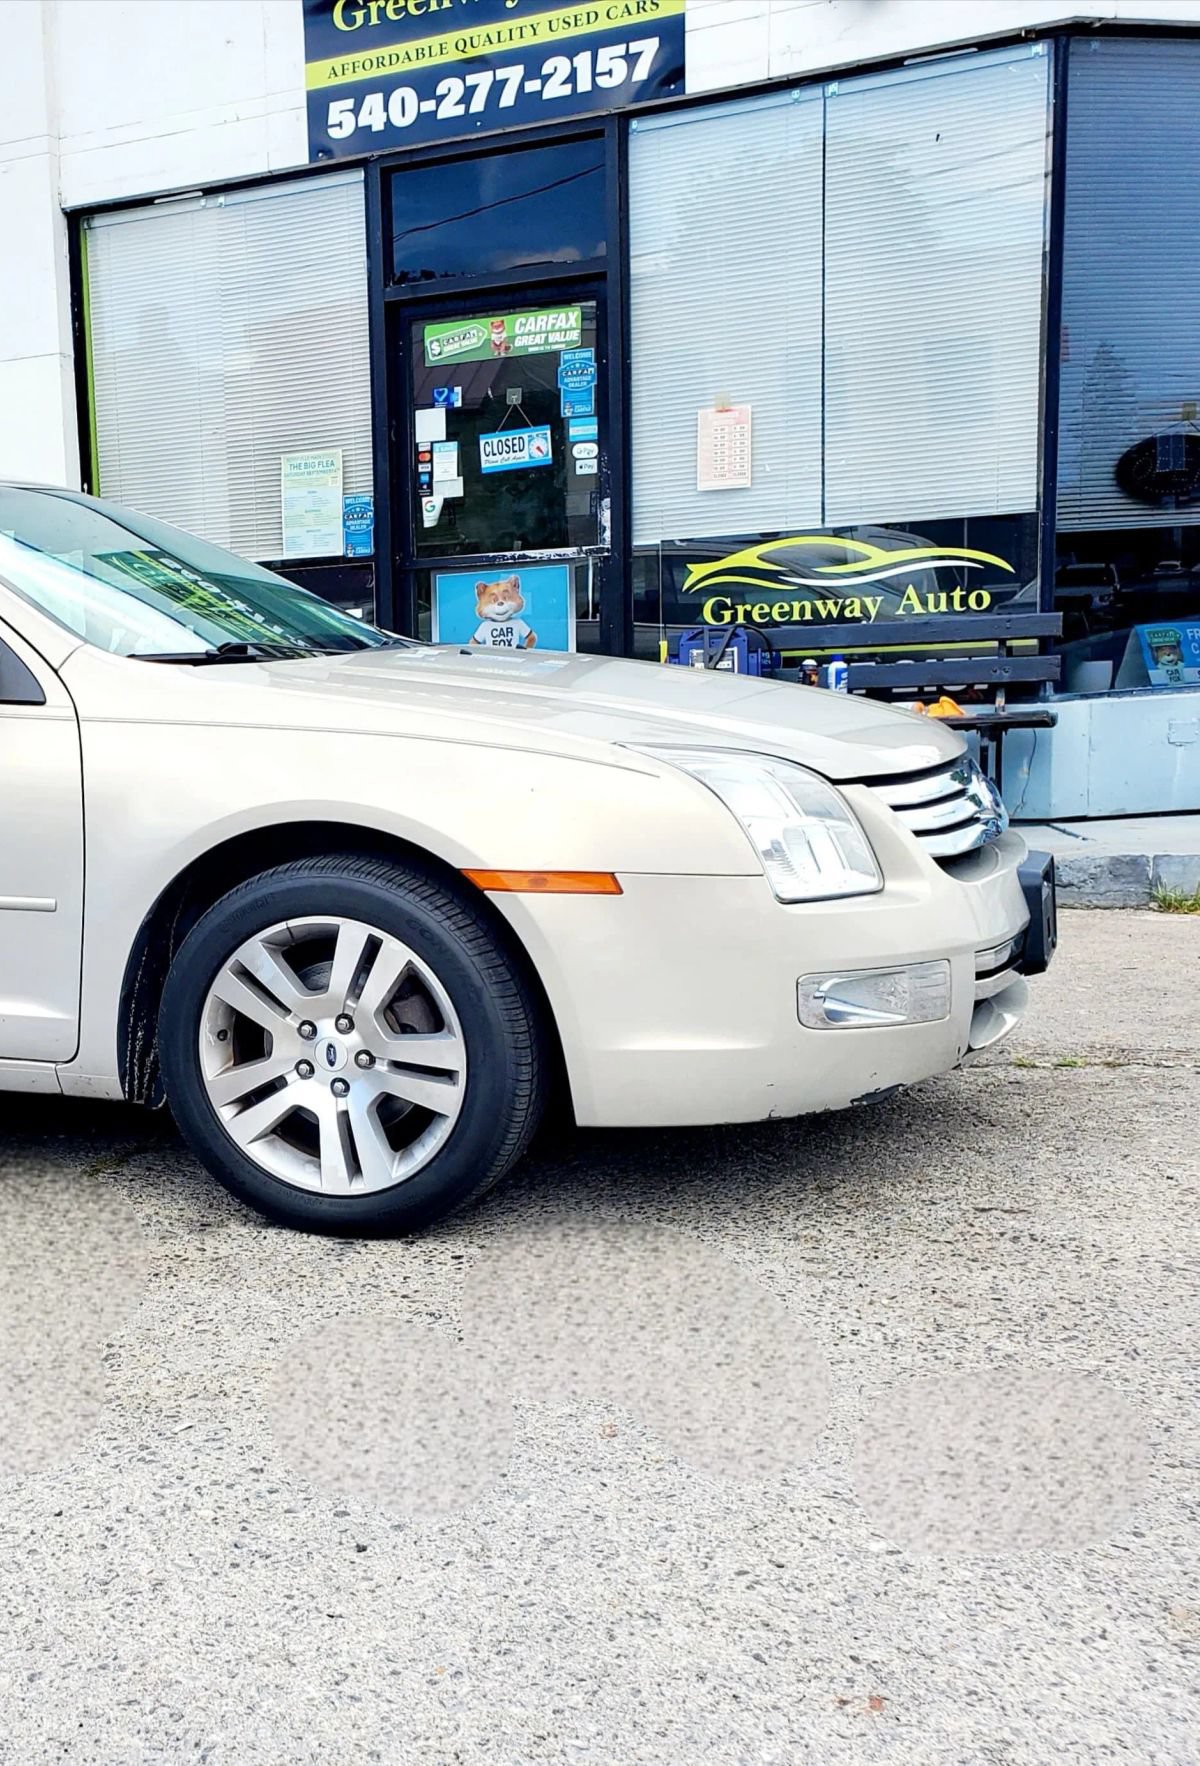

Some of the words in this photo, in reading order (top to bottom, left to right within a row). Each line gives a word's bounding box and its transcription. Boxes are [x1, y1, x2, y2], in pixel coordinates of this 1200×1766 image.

[332, 0, 519, 31] Green
[327, 43, 449, 80] AFFORDABLE
[454, 22, 541, 54] QUALITY
[547, 10, 599, 35] USED
[605, 0, 661, 21] CARS
[326, 37, 661, 140] 540-277-2157
[514, 311, 578, 334] CARFAX
[514, 334, 546, 348] GREAT
[548, 329, 580, 344] VALUE
[563, 351, 592, 360] WELCOME
[562, 367, 594, 377] CARFAX
[483, 436, 525, 457] CLOSED
[288, 462, 303, 471] THE
[304, 461, 316, 470] BIG
[317, 459, 335, 468] FLEA
[345, 496, 370, 504] WELCOME
[344, 511, 373, 520] CARFAX
[702, 594, 884, 626] Greenway
[895, 583, 992, 615] Auto
[491, 626, 513, 638] CAR
[491, 638, 513, 647] FOX
